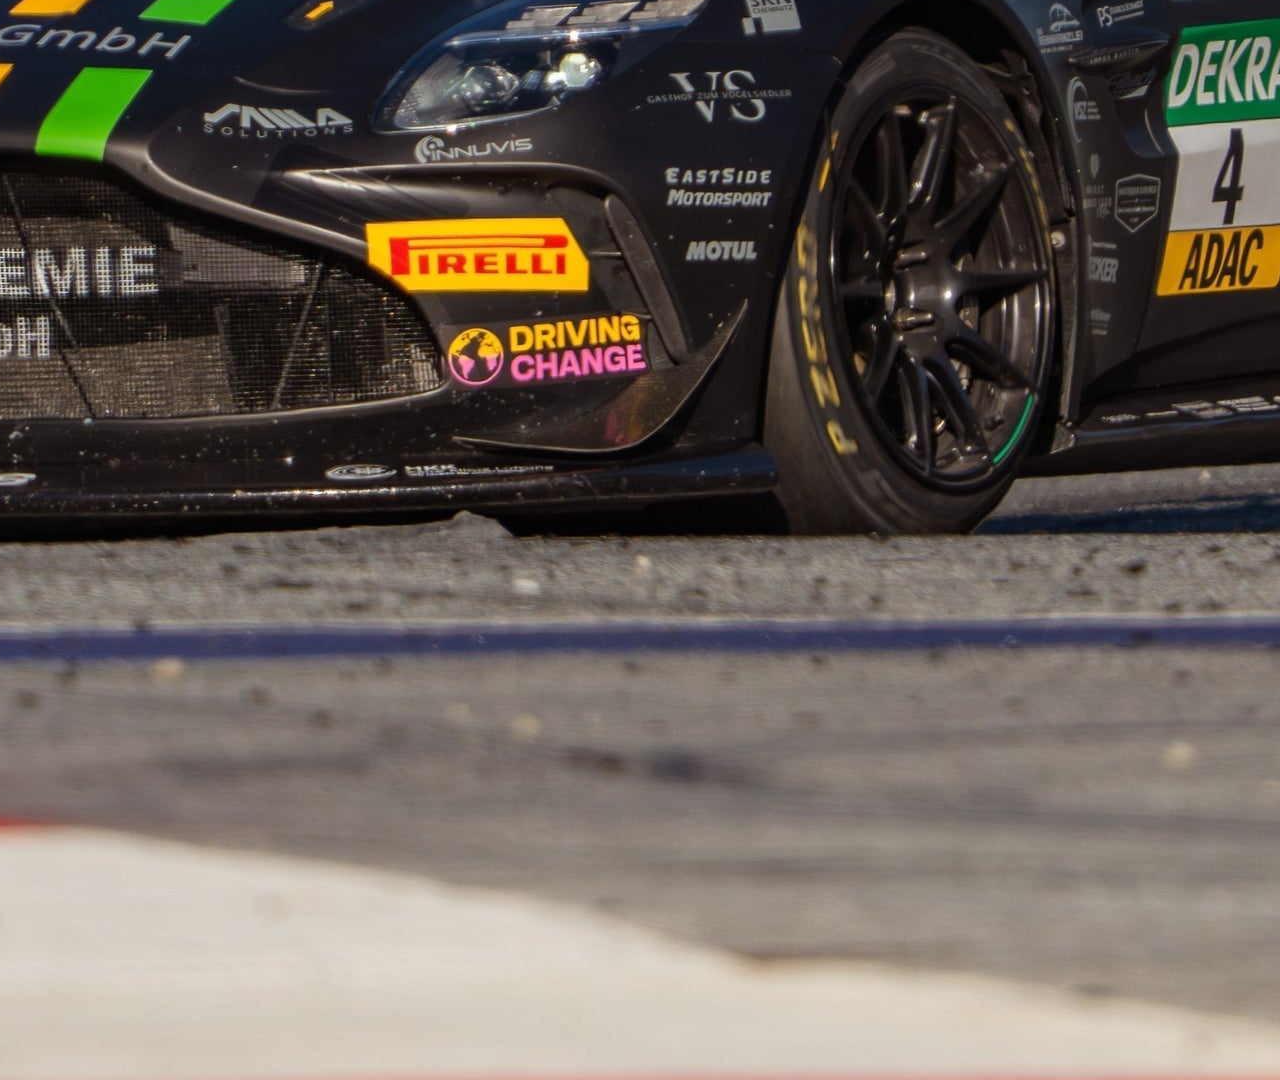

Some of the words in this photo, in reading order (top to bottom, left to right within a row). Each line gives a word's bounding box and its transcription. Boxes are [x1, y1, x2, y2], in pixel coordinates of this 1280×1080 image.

[752, 4, 794, 15] CHEMNITZ
[668, 69, 767, 123] VS
[697, 91, 720, 100] ZUM
[203, 123, 354, 139] SOLUTIONS
[1211, 127, 1246, 226] 4
[388, 234, 570, 276] PIRELLI
[685, 240, 758, 262] MOTUL
[1177, 228, 1264, 290] ADAC
[508, 314, 642, 353] DRIVING
[510, 344, 647, 382] CHANGE
